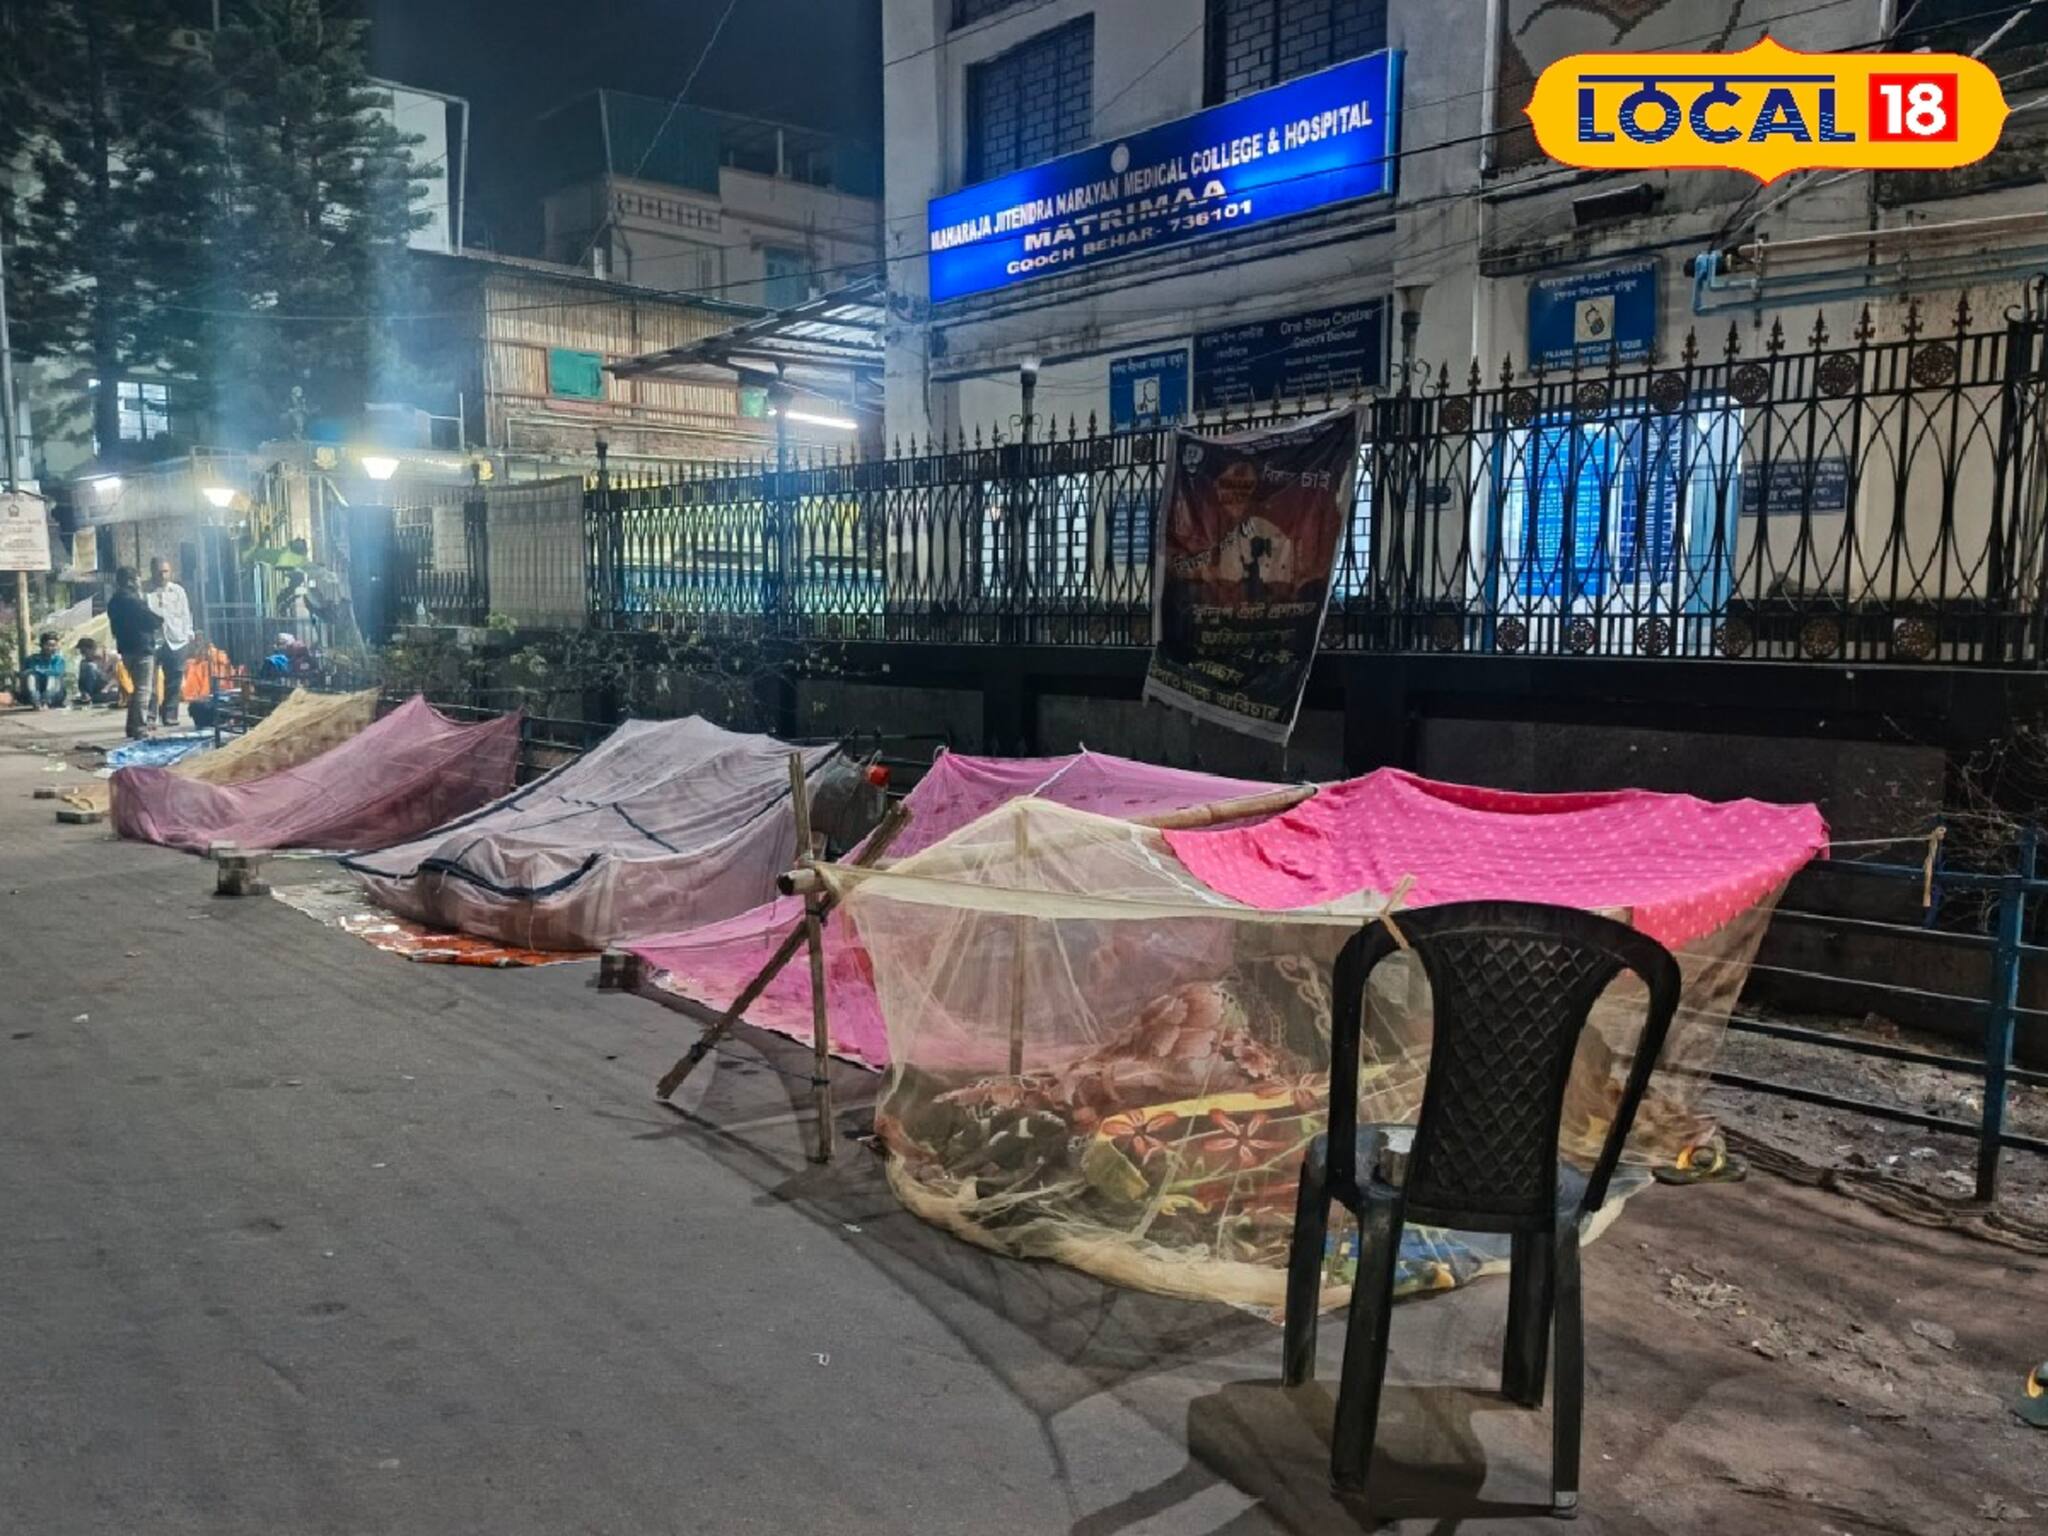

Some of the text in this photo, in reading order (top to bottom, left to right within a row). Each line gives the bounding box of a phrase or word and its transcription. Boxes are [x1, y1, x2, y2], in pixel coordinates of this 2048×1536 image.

[931, 100, 1373, 251] MAHARAJA JITENDRA NARAYAN MEDICAL COLLEGE & HOSPITAL
[1007, 246, 1075, 276] COOCH
[1169, 200, 1252, 232] 736101
[1024, 179, 1228, 252] MATRIMAA
